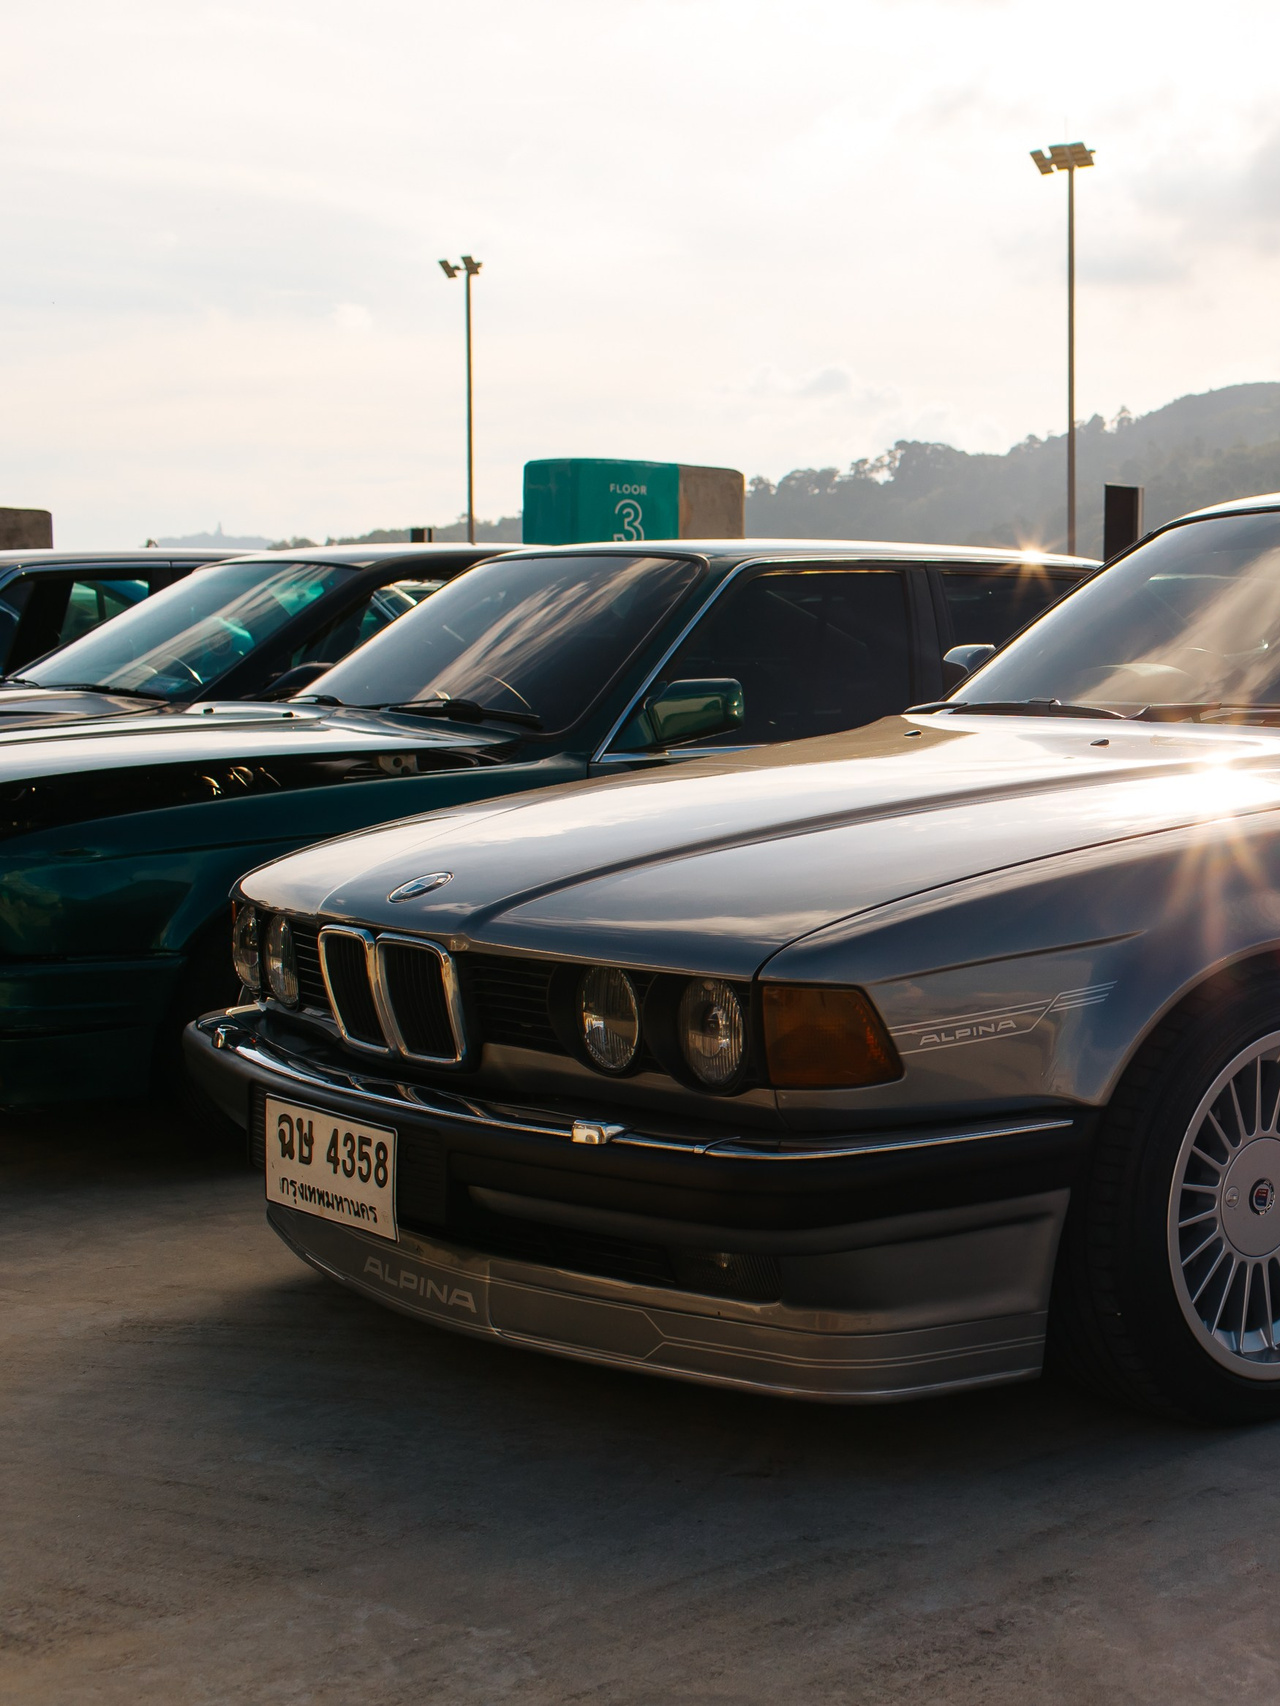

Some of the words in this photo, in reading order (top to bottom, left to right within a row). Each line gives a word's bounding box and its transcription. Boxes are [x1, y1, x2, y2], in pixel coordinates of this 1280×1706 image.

[609, 483, 647, 495] FLOOR
[613, 499, 645, 541] 3
[919, 1019, 1017, 1046] ALPINA
[278, 1113, 314, 1165] ฉษ
[326, 1128, 388, 1188] 4358
[280, 1177, 378, 1223] กรุงเทพมหานคร
[363, 1255, 477, 1313] ALPINA
